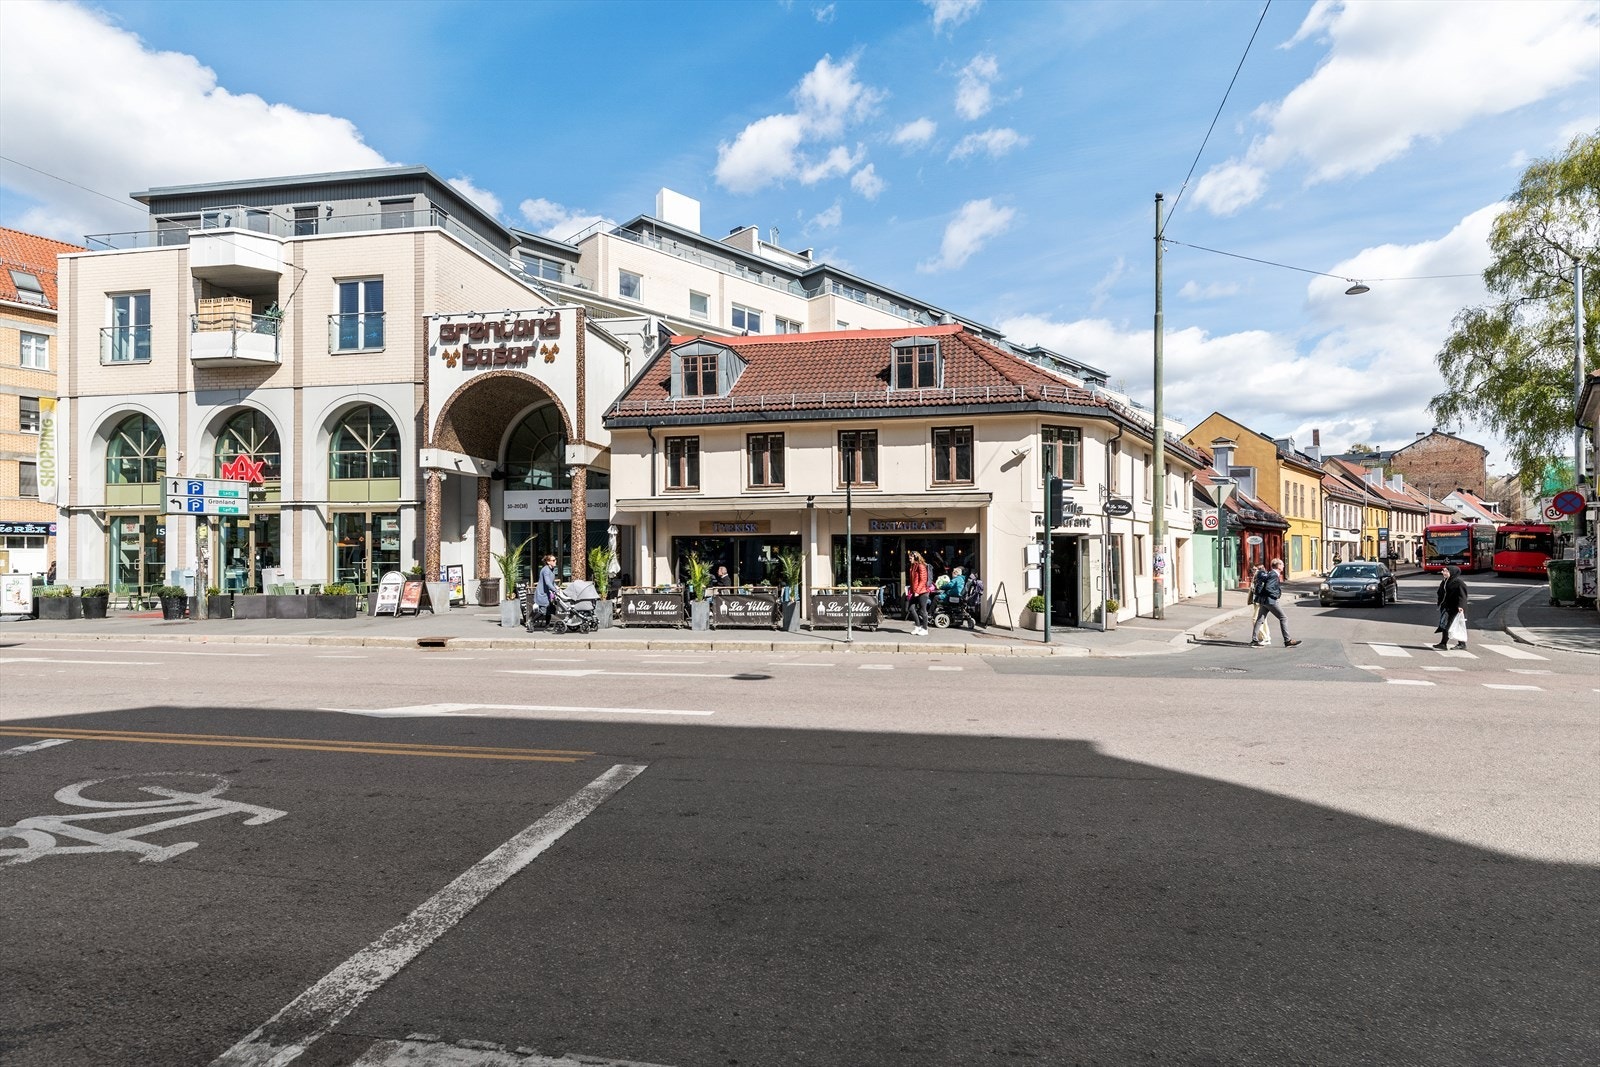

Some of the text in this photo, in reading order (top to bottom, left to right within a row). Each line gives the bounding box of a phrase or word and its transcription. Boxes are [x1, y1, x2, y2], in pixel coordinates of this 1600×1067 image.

[440, 312, 561, 341] grønland
[463, 343, 537, 366] basar
[40, 418, 56, 488] SHOPPING
[221, 454, 264, 483] MAX
[1548, 509, 1561, 517] 30
[871, 520, 944, 530] RESTAURANT
[1207, 518, 1216, 526] 30
[713, 523, 758, 532] TYRKISK
[636, 600, 678, 610] La Villa
[728, 601, 772, 611] La Villa
[826, 601, 844, 612] La
